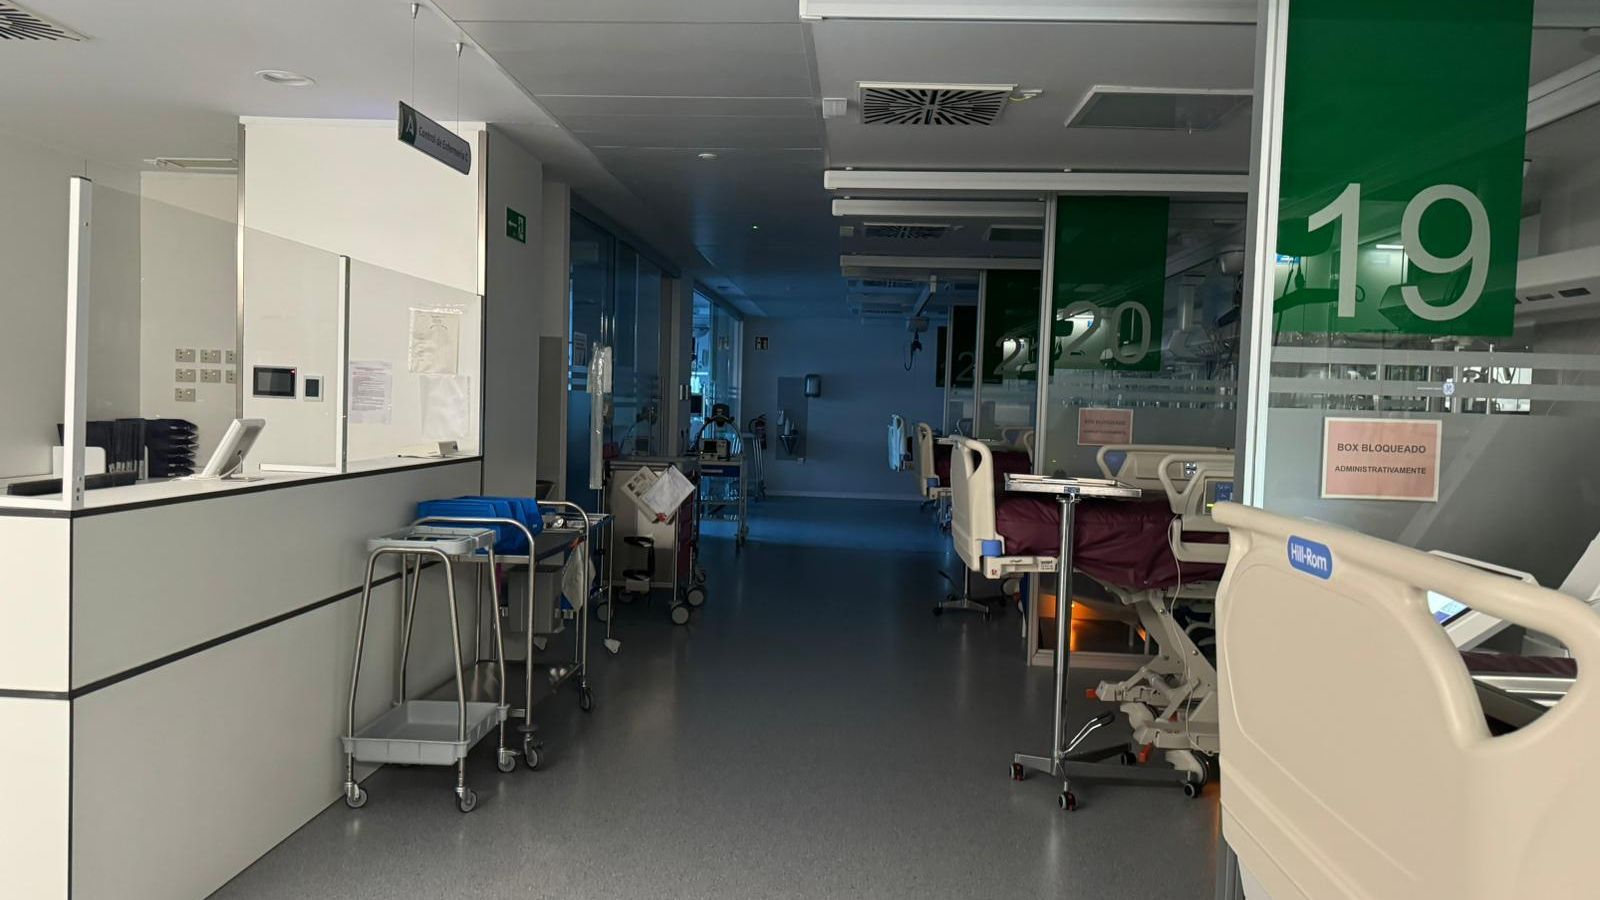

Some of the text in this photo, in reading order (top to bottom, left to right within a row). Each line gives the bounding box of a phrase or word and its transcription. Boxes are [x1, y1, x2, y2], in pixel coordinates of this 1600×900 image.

[1307, 182, 1492, 322] 19
[1062, 300, 1152, 365] 20
[1337, 442, 1427, 454] BOX BLOQUEADO
[1335, 465, 1427, 475] ADMINISTRATIVAMENTE
[1290, 542, 1328, 572] Hill-Rom
